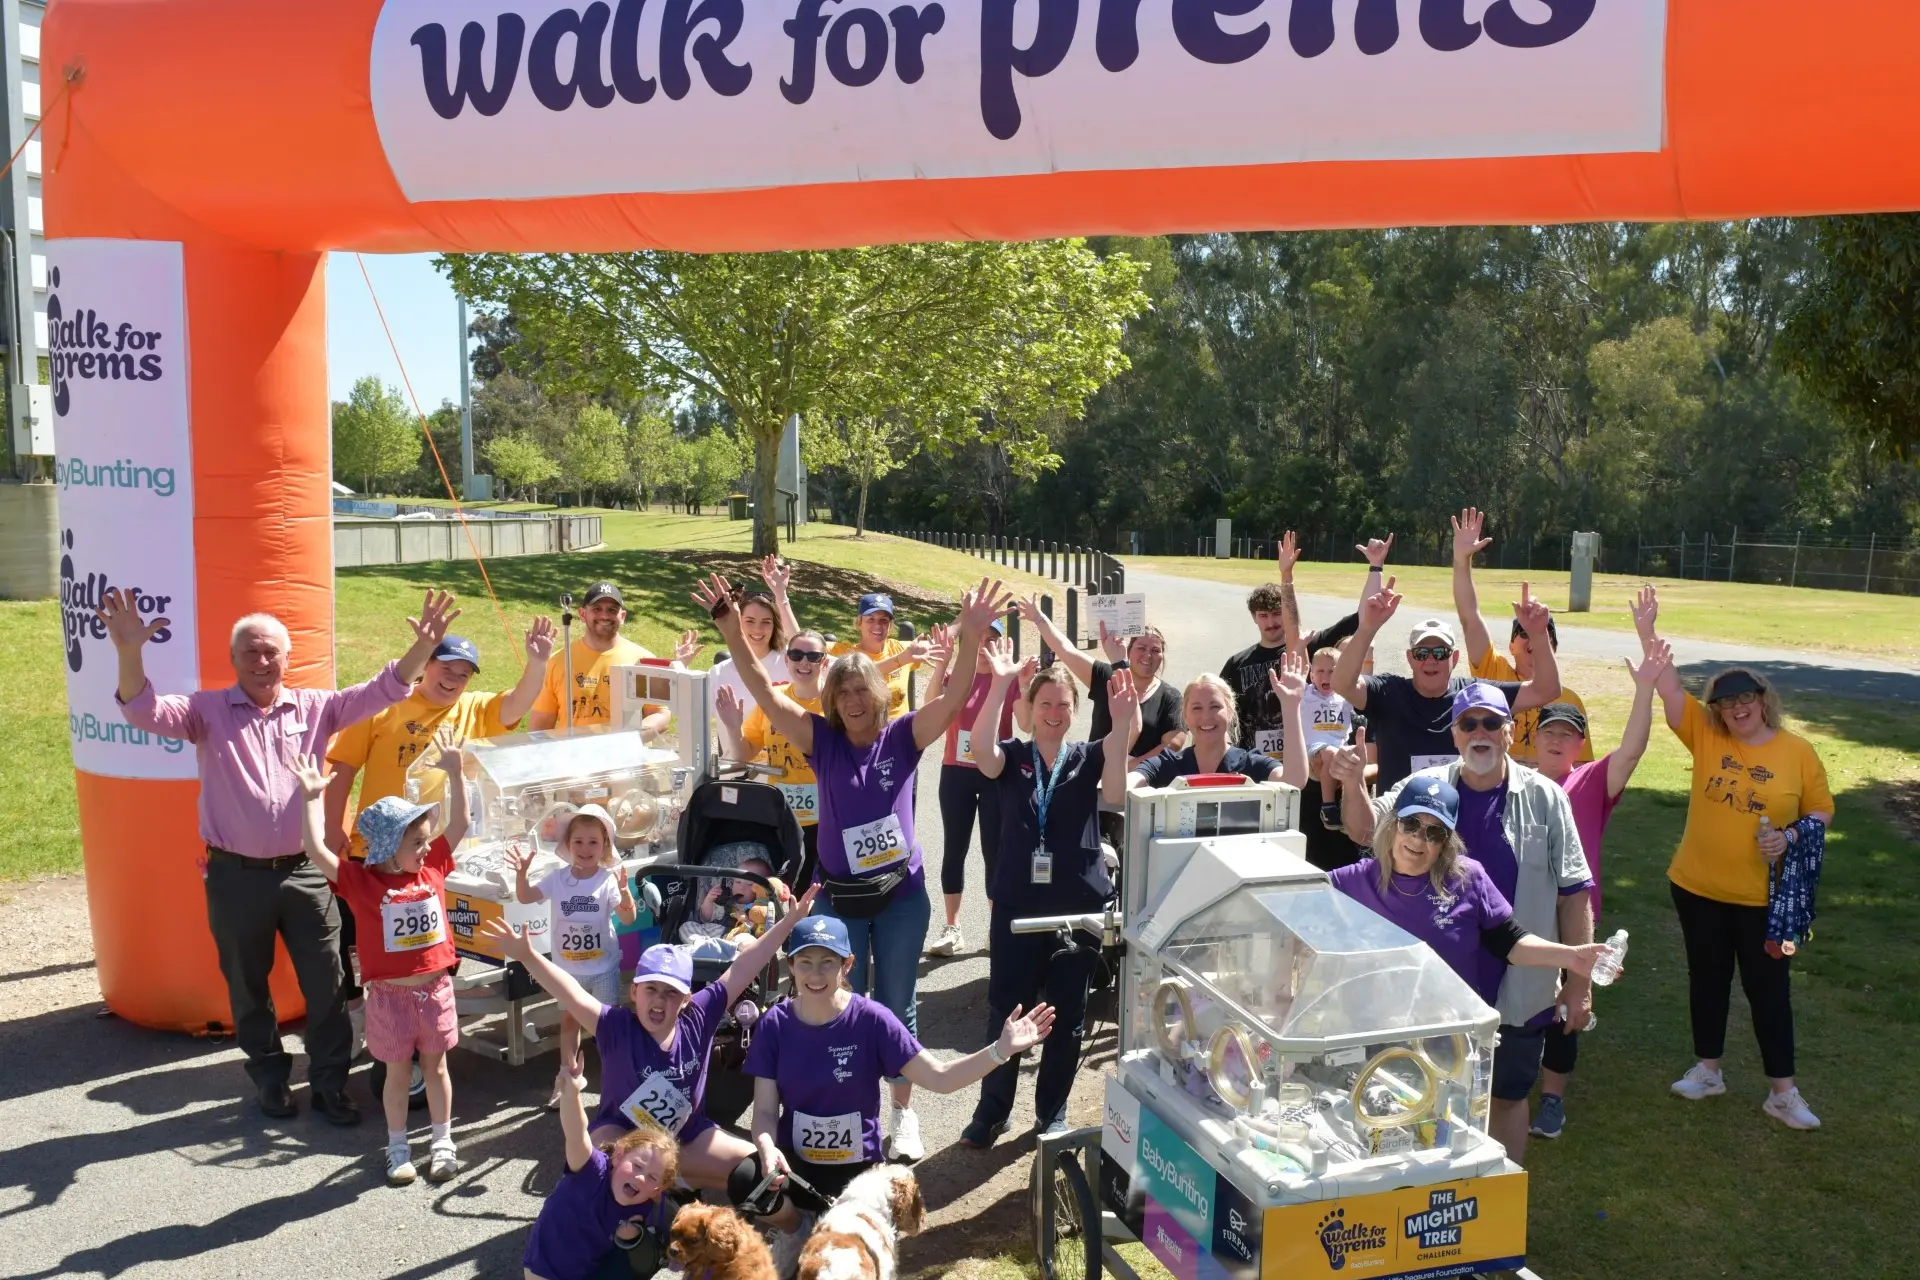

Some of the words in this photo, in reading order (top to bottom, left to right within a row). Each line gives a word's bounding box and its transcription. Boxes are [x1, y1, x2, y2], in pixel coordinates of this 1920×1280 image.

[410, 0, 753, 119] walk
[779, 0, 945, 105] for
[114, 322, 162, 352] for
[52, 352, 163, 396] prems
[64, 611, 172, 652] pres
[1314, 709, 1344, 724] 2154
[853, 829, 898, 859] 2985
[457, 900, 469, 910] THE
[393, 911, 439, 936] 2989
[447, 911, 479, 924] MIGHTY
[512, 918, 548, 933] btax
[455, 924, 473, 938] TREK
[561, 933, 601, 951] 2981
[1108, 1104, 1132, 1138] britax
[801, 1128, 853, 1149] 2224
[1142, 1137, 1208, 1220] BabyBunting
[1431, 1192, 1453, 1205] THE
[1407, 1200, 1475, 1236] MIGHTY
[1222, 1229, 1252, 1260] FURPHY
[1325, 1222, 1369, 1245] walk
[1369, 1225, 1387, 1238] for
[1424, 1229, 1457, 1246] TREK
[1332, 1236, 1386, 1262] prems
[1416, 1248, 1462, 1261] CHALLENGE
[1404, 1271, 1435, 1280] Treasures
[1435, 1265, 1474, 1277] Foundation
